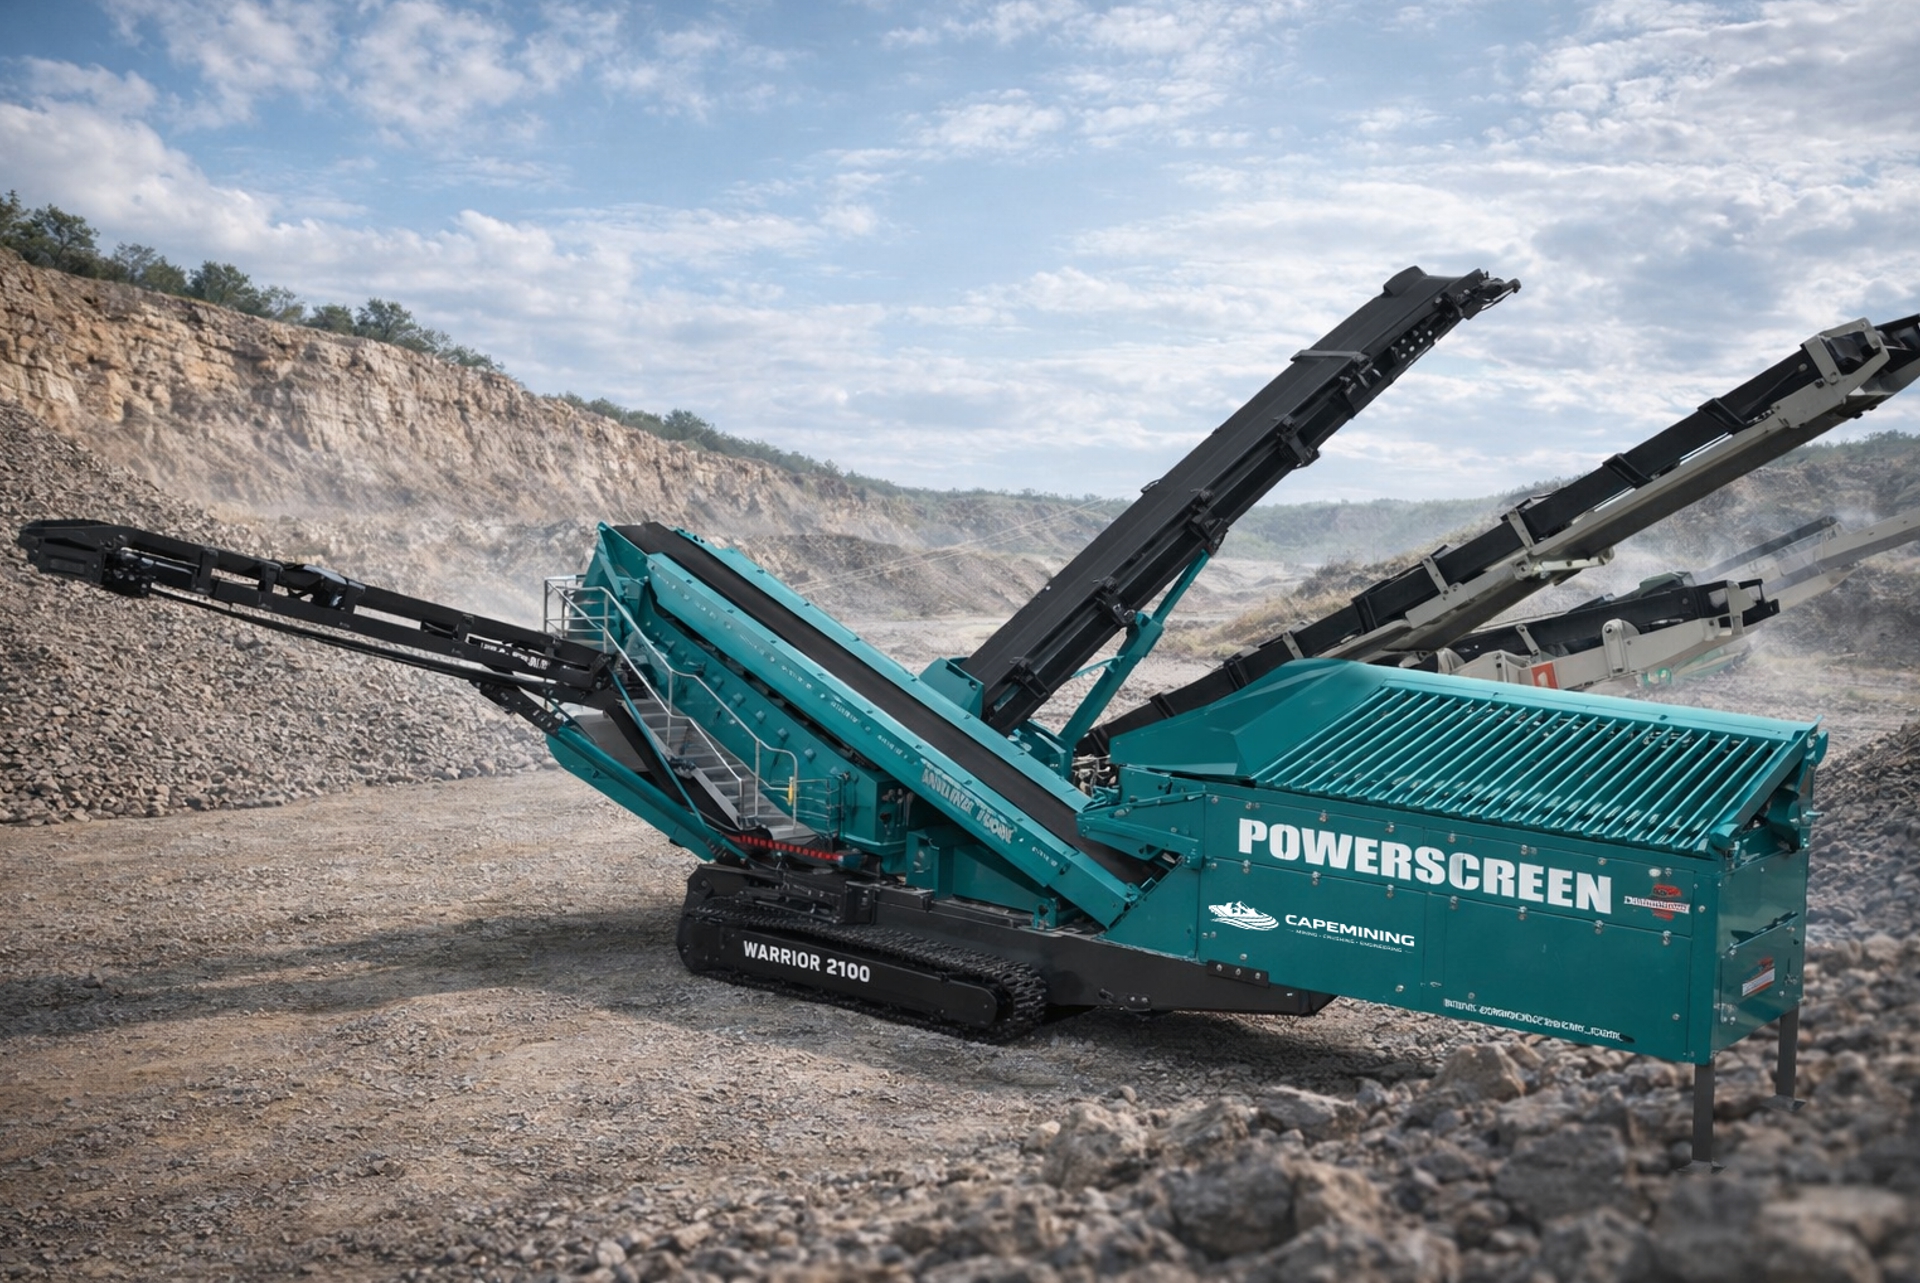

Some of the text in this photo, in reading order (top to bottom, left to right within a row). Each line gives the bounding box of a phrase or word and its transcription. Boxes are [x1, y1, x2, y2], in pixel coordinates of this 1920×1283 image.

[1238, 818, 1612, 915] POWERSCREEN
[1285, 915, 1415, 947] CAPEMINING
[743, 940, 871, 983] WARRIOR 2100
